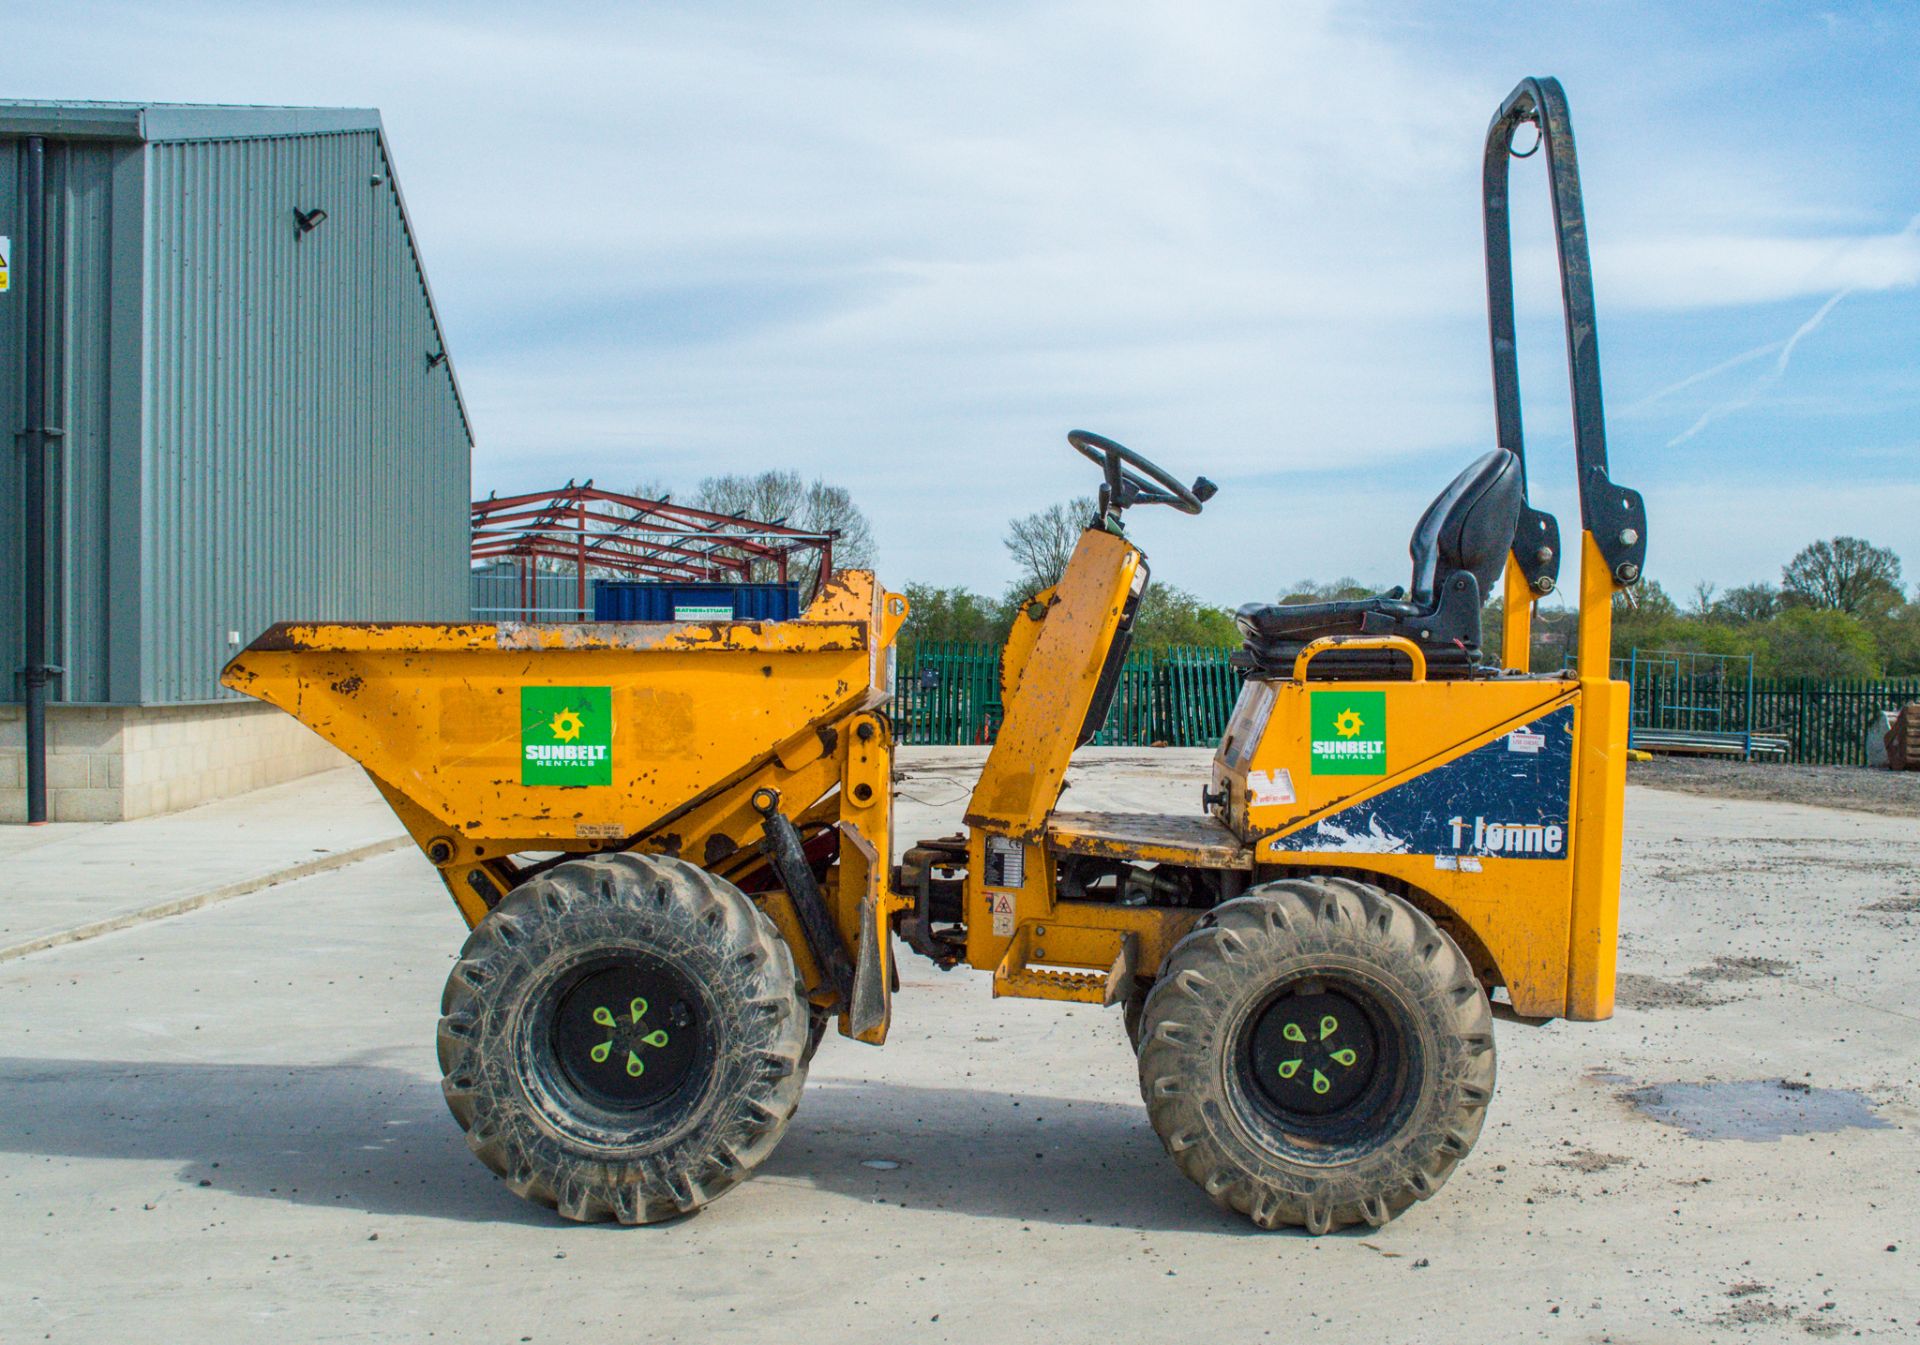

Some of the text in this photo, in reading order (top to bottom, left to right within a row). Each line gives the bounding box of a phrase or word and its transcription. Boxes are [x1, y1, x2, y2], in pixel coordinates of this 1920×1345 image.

[525, 745, 607, 760] SUNBELT
[1312, 741, 1384, 754] SUNBELT
[1448, 816, 1562, 853] 1 tonne
